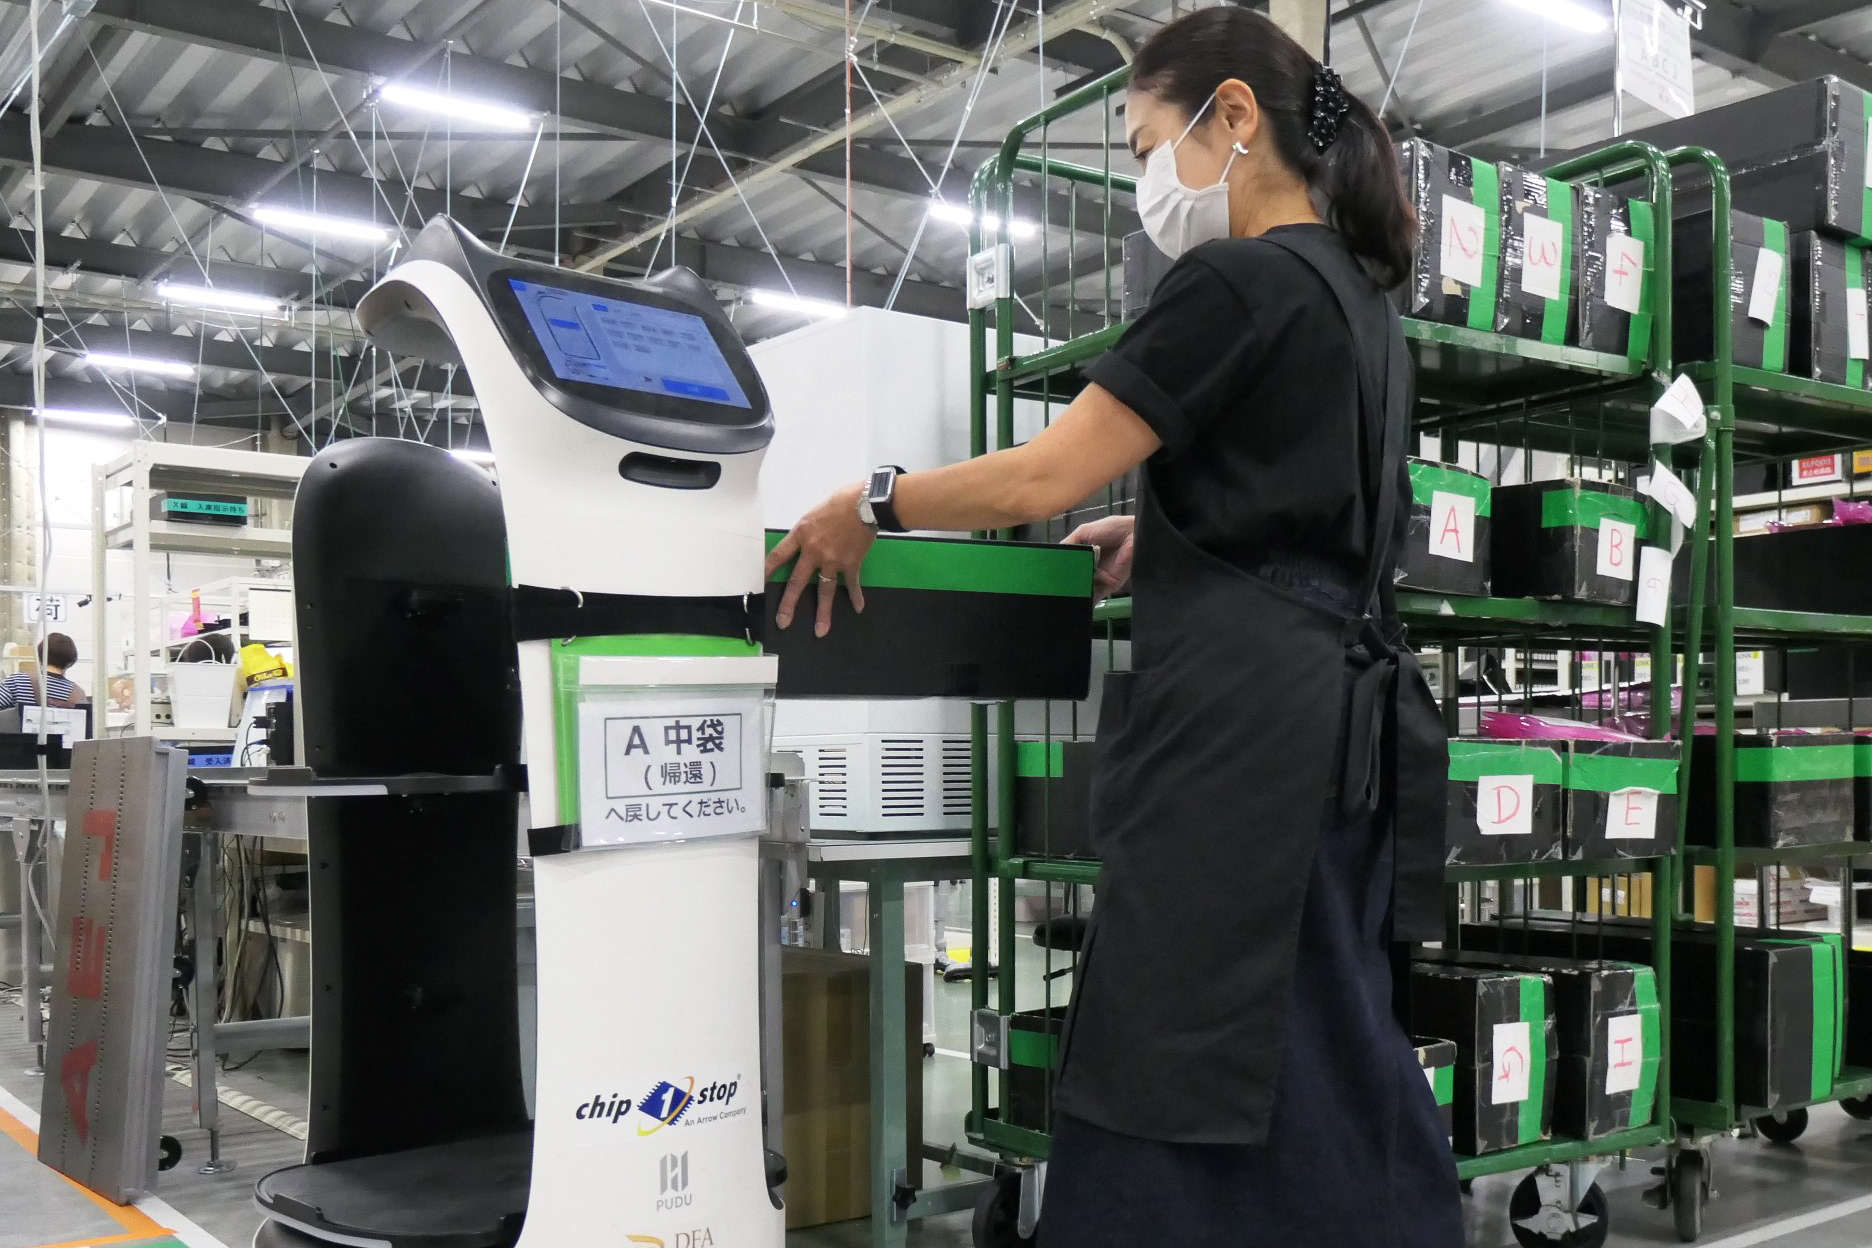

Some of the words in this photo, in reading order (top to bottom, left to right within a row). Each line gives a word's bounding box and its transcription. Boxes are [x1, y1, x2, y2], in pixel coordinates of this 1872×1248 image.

[1448, 215, 1479, 259] 2
[1528, 236, 1557, 267] 3
[1612, 250, 1638, 287] 4
[1439, 504, 1462, 554] A
[1609, 528, 1624, 567] B
[624, 725, 650, 756] A
[663, 718, 725, 756] 中袋
[605, 797, 746, 823] へ戻してください。
[1491, 785, 1521, 824] D
[1624, 791, 1644, 826] E
[1498, 1046, 1524, 1083] G
[575, 1092, 632, 1124] chip
[684, 1118, 695, 1127] An
[696, 1113, 718, 1125] Arrow
[719, 1106, 748, 1120] Company
[656, 1194, 693, 1212] PUDU
[675, 1227, 714, 1248] DFA
